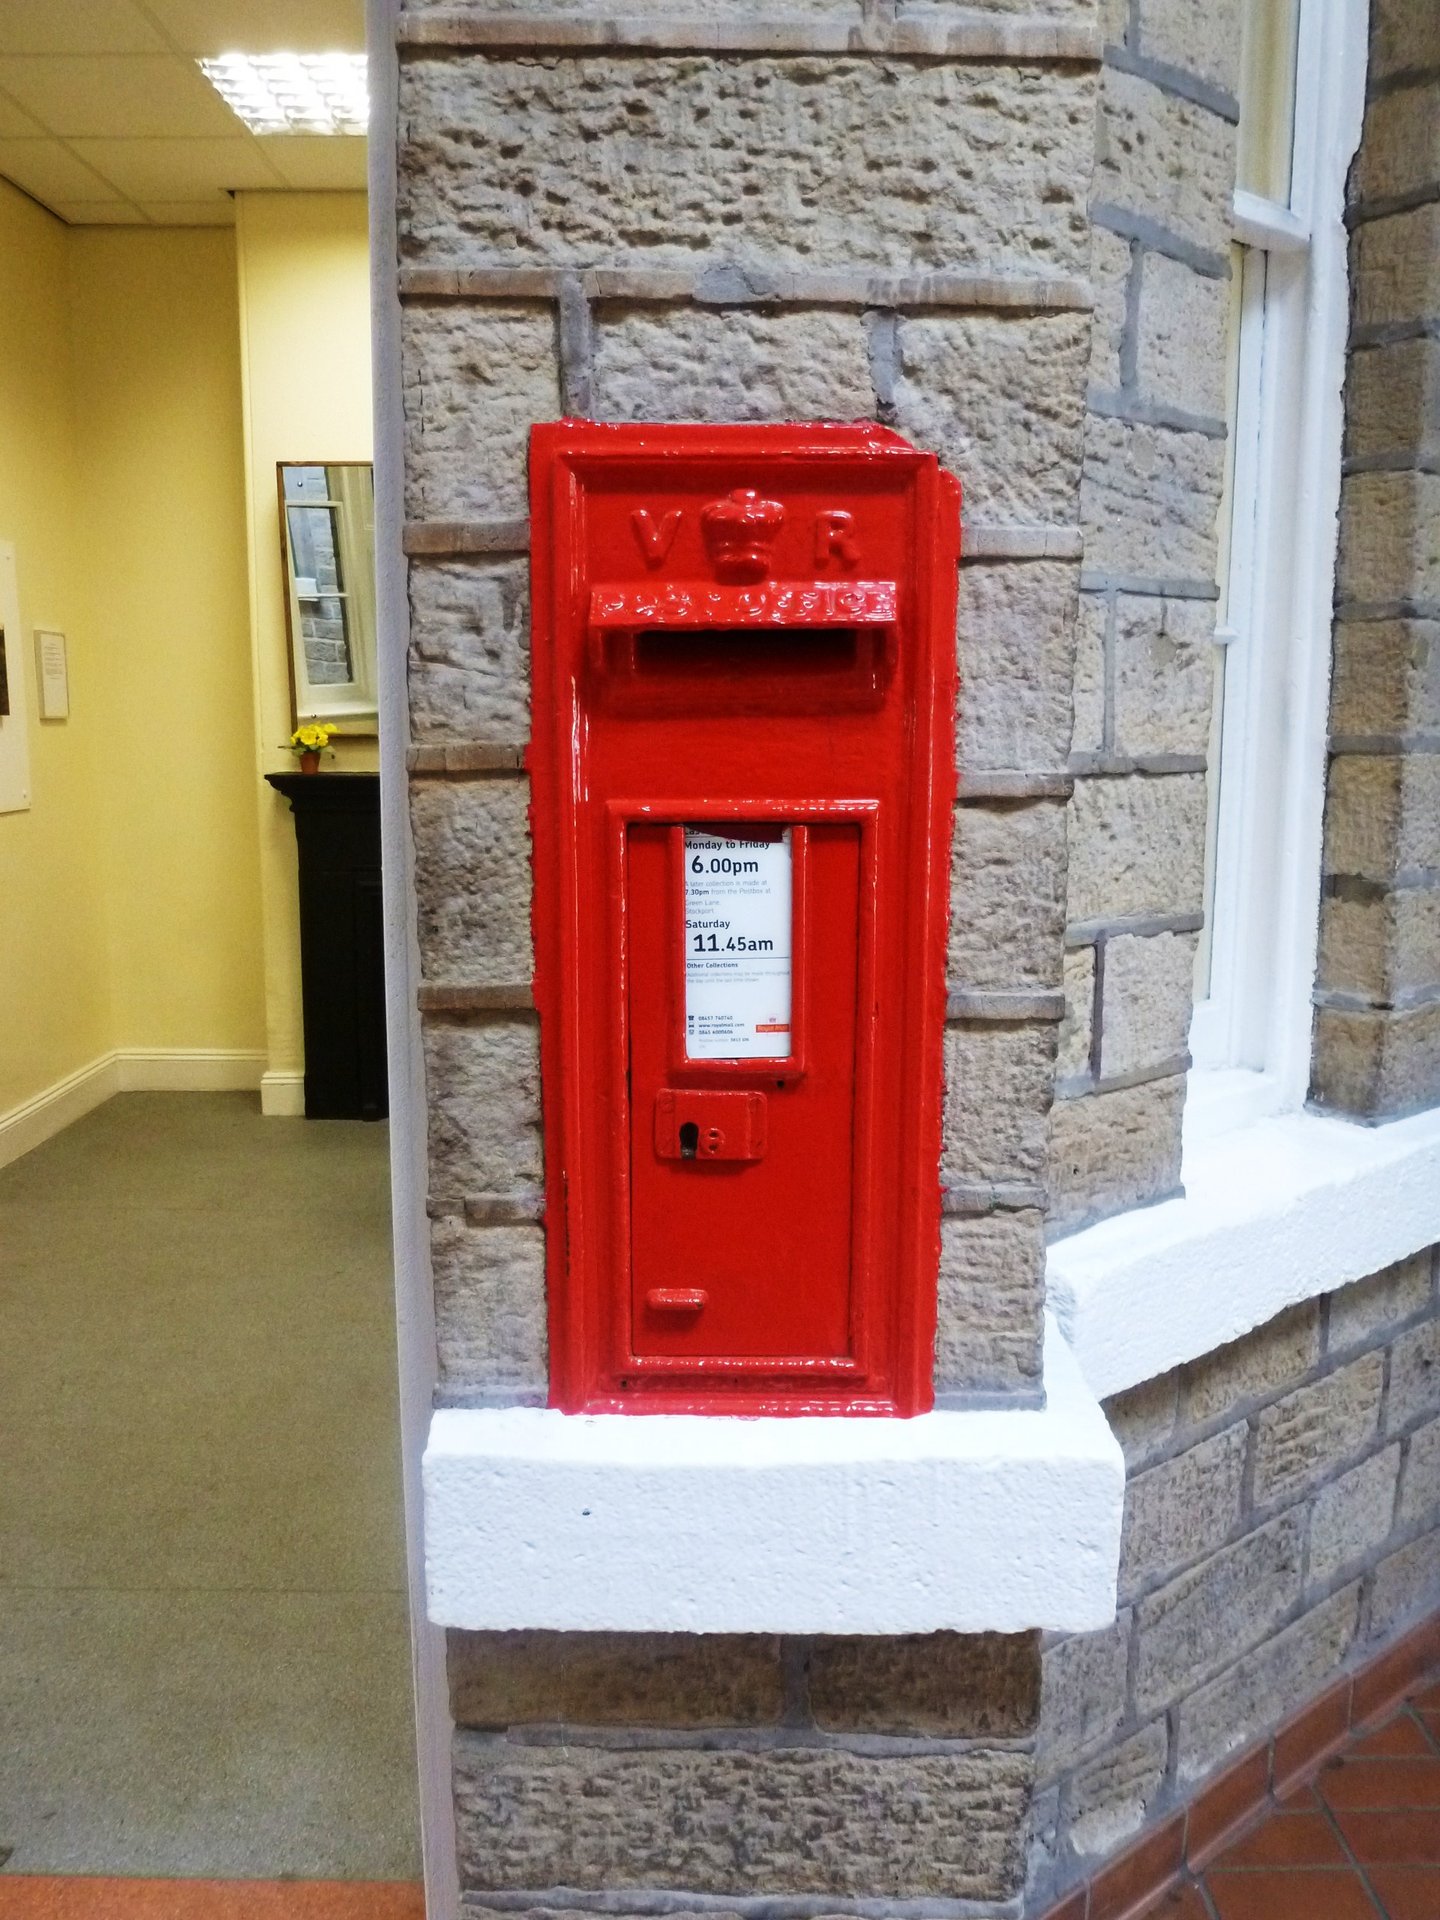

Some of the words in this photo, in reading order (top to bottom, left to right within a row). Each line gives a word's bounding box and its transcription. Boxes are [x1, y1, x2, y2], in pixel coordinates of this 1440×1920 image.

[630, 508, 682, 571] V
[815, 509, 861, 571] R
[685, 841, 722, 851] Monday
[725, 841, 736, 849] to
[691, 855, 759, 876] 6.00pm
[685, 919, 731, 930] Saturday
[693, 933, 774, 953] 11.45am
